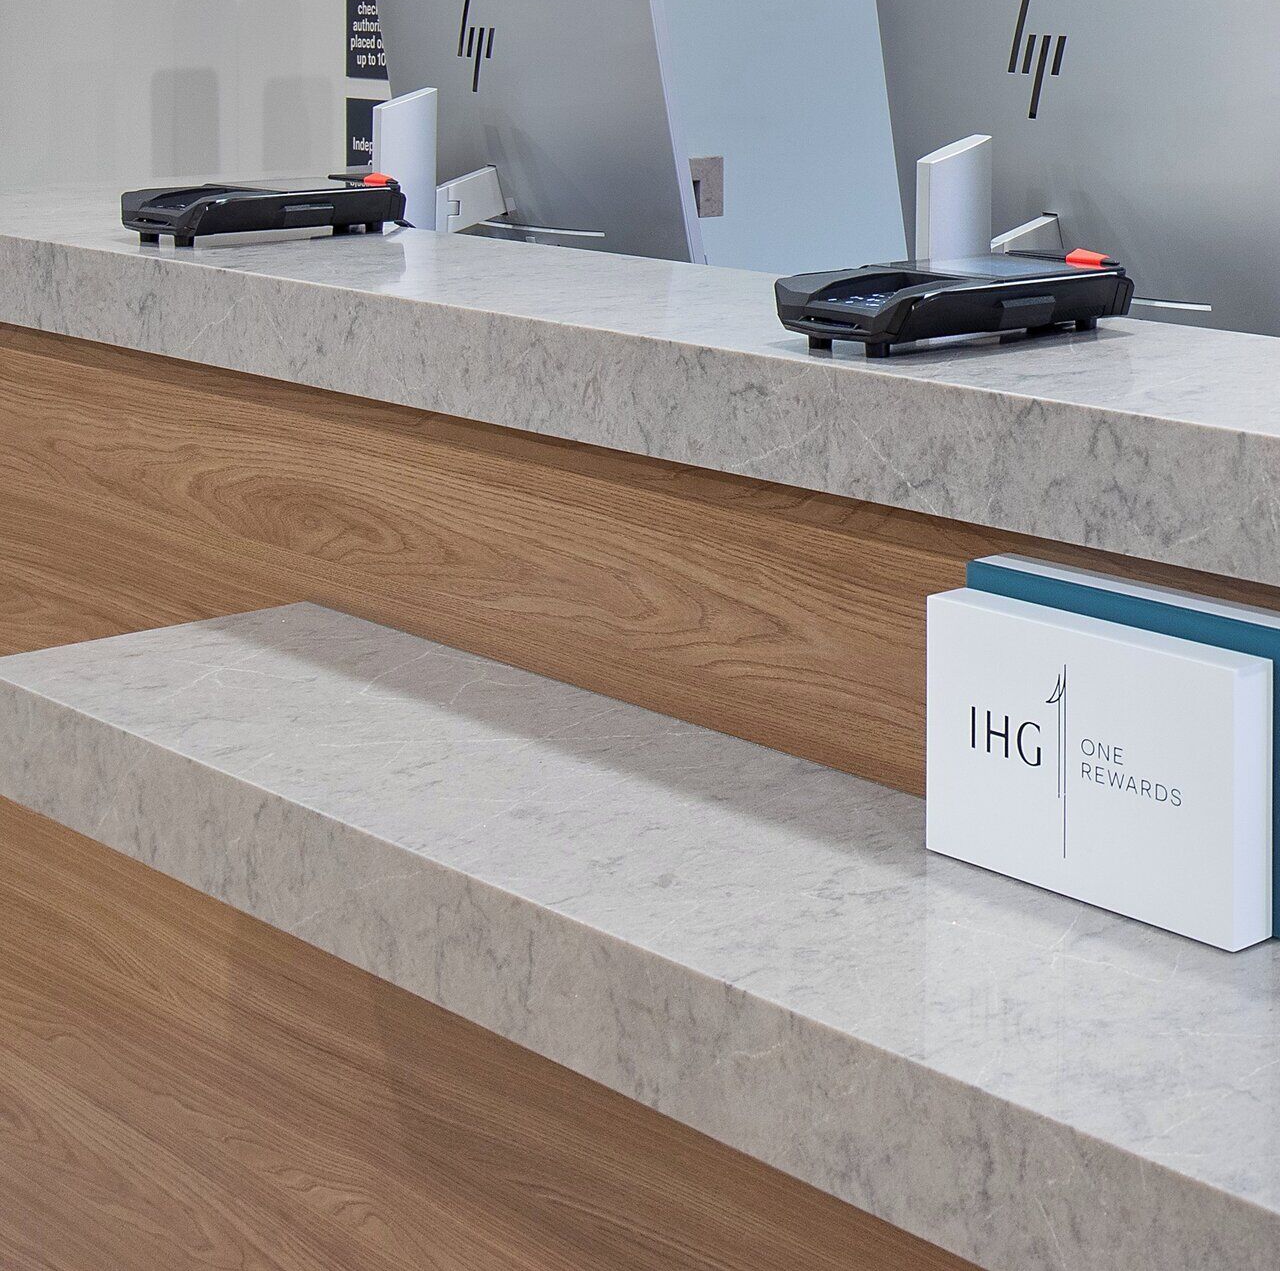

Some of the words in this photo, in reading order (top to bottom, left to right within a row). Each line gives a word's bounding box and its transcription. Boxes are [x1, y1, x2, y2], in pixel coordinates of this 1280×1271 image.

[350, 34, 376, 51] placed
[356, 54, 367, 68] up
[368, 52, 376, 66] to
[970, 706, 1041, 766] IHG
[1080, 739, 1123, 766] ONE
[1080, 762, 1183, 807] REWARDS
